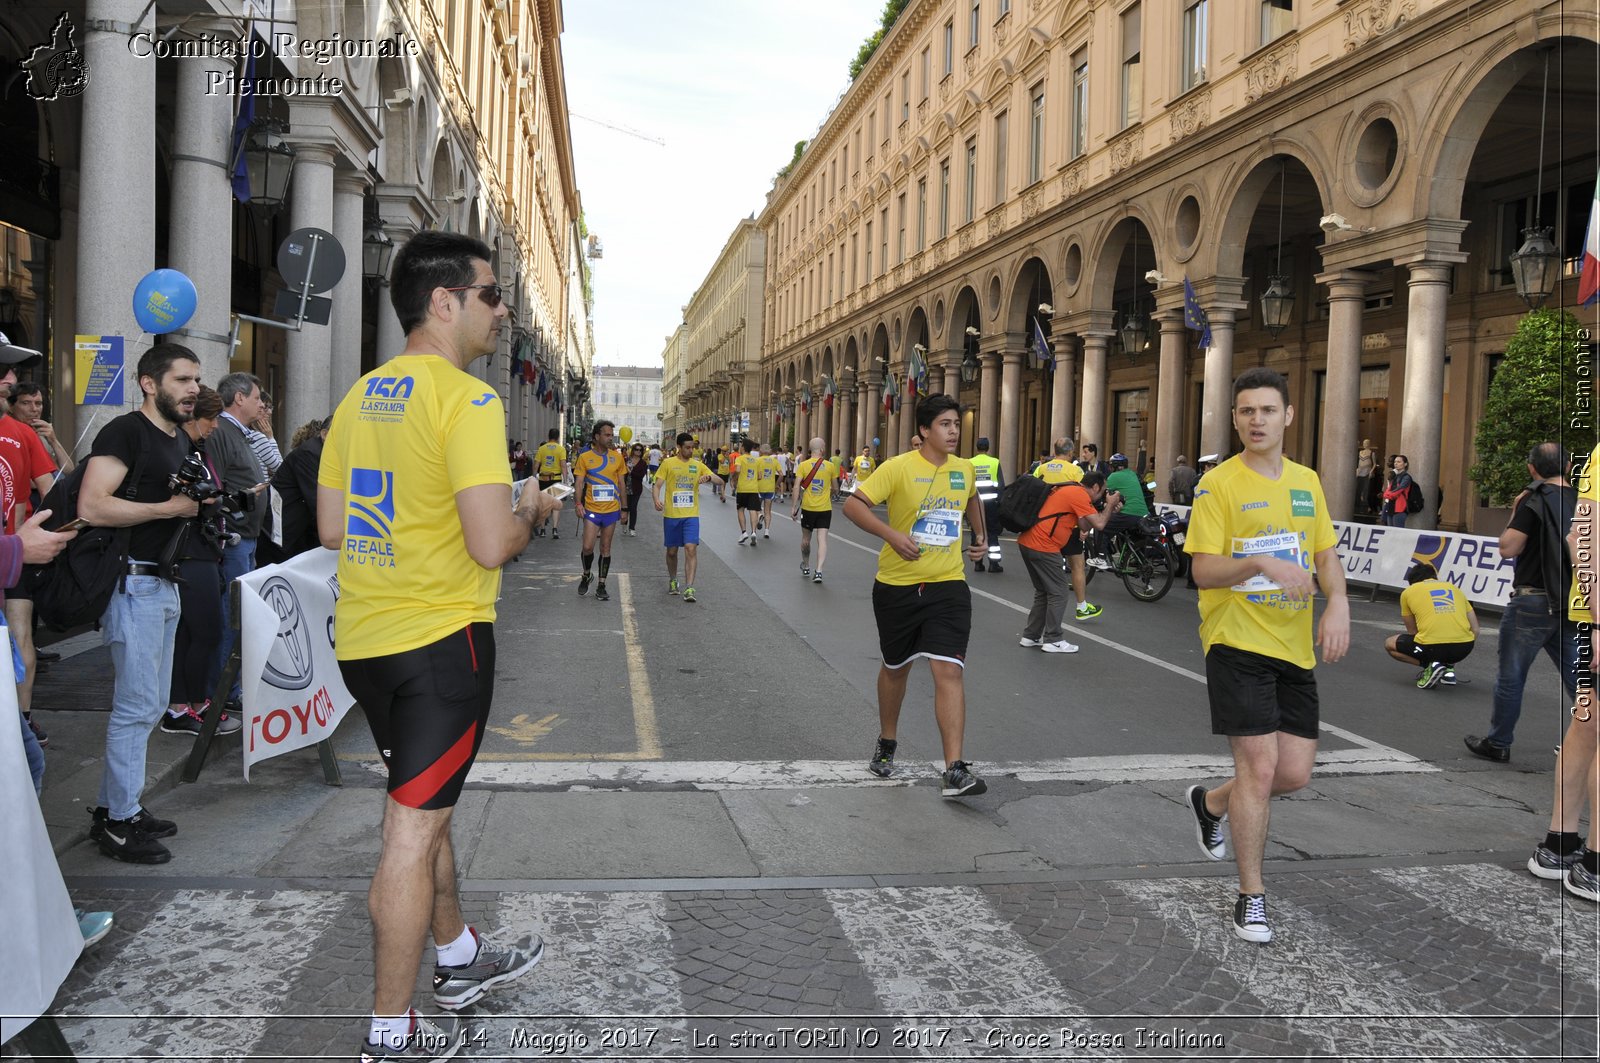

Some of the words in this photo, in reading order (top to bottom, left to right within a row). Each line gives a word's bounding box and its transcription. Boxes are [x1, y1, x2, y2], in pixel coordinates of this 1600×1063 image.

[364, 376, 415, 399] 150
[925, 522, 947, 536] 4743
[347, 539, 395, 557] REALE
[1333, 525, 1386, 554] ALE
[347, 554, 396, 568] MUTUA
[250, 685, 335, 752] TOYOTA
